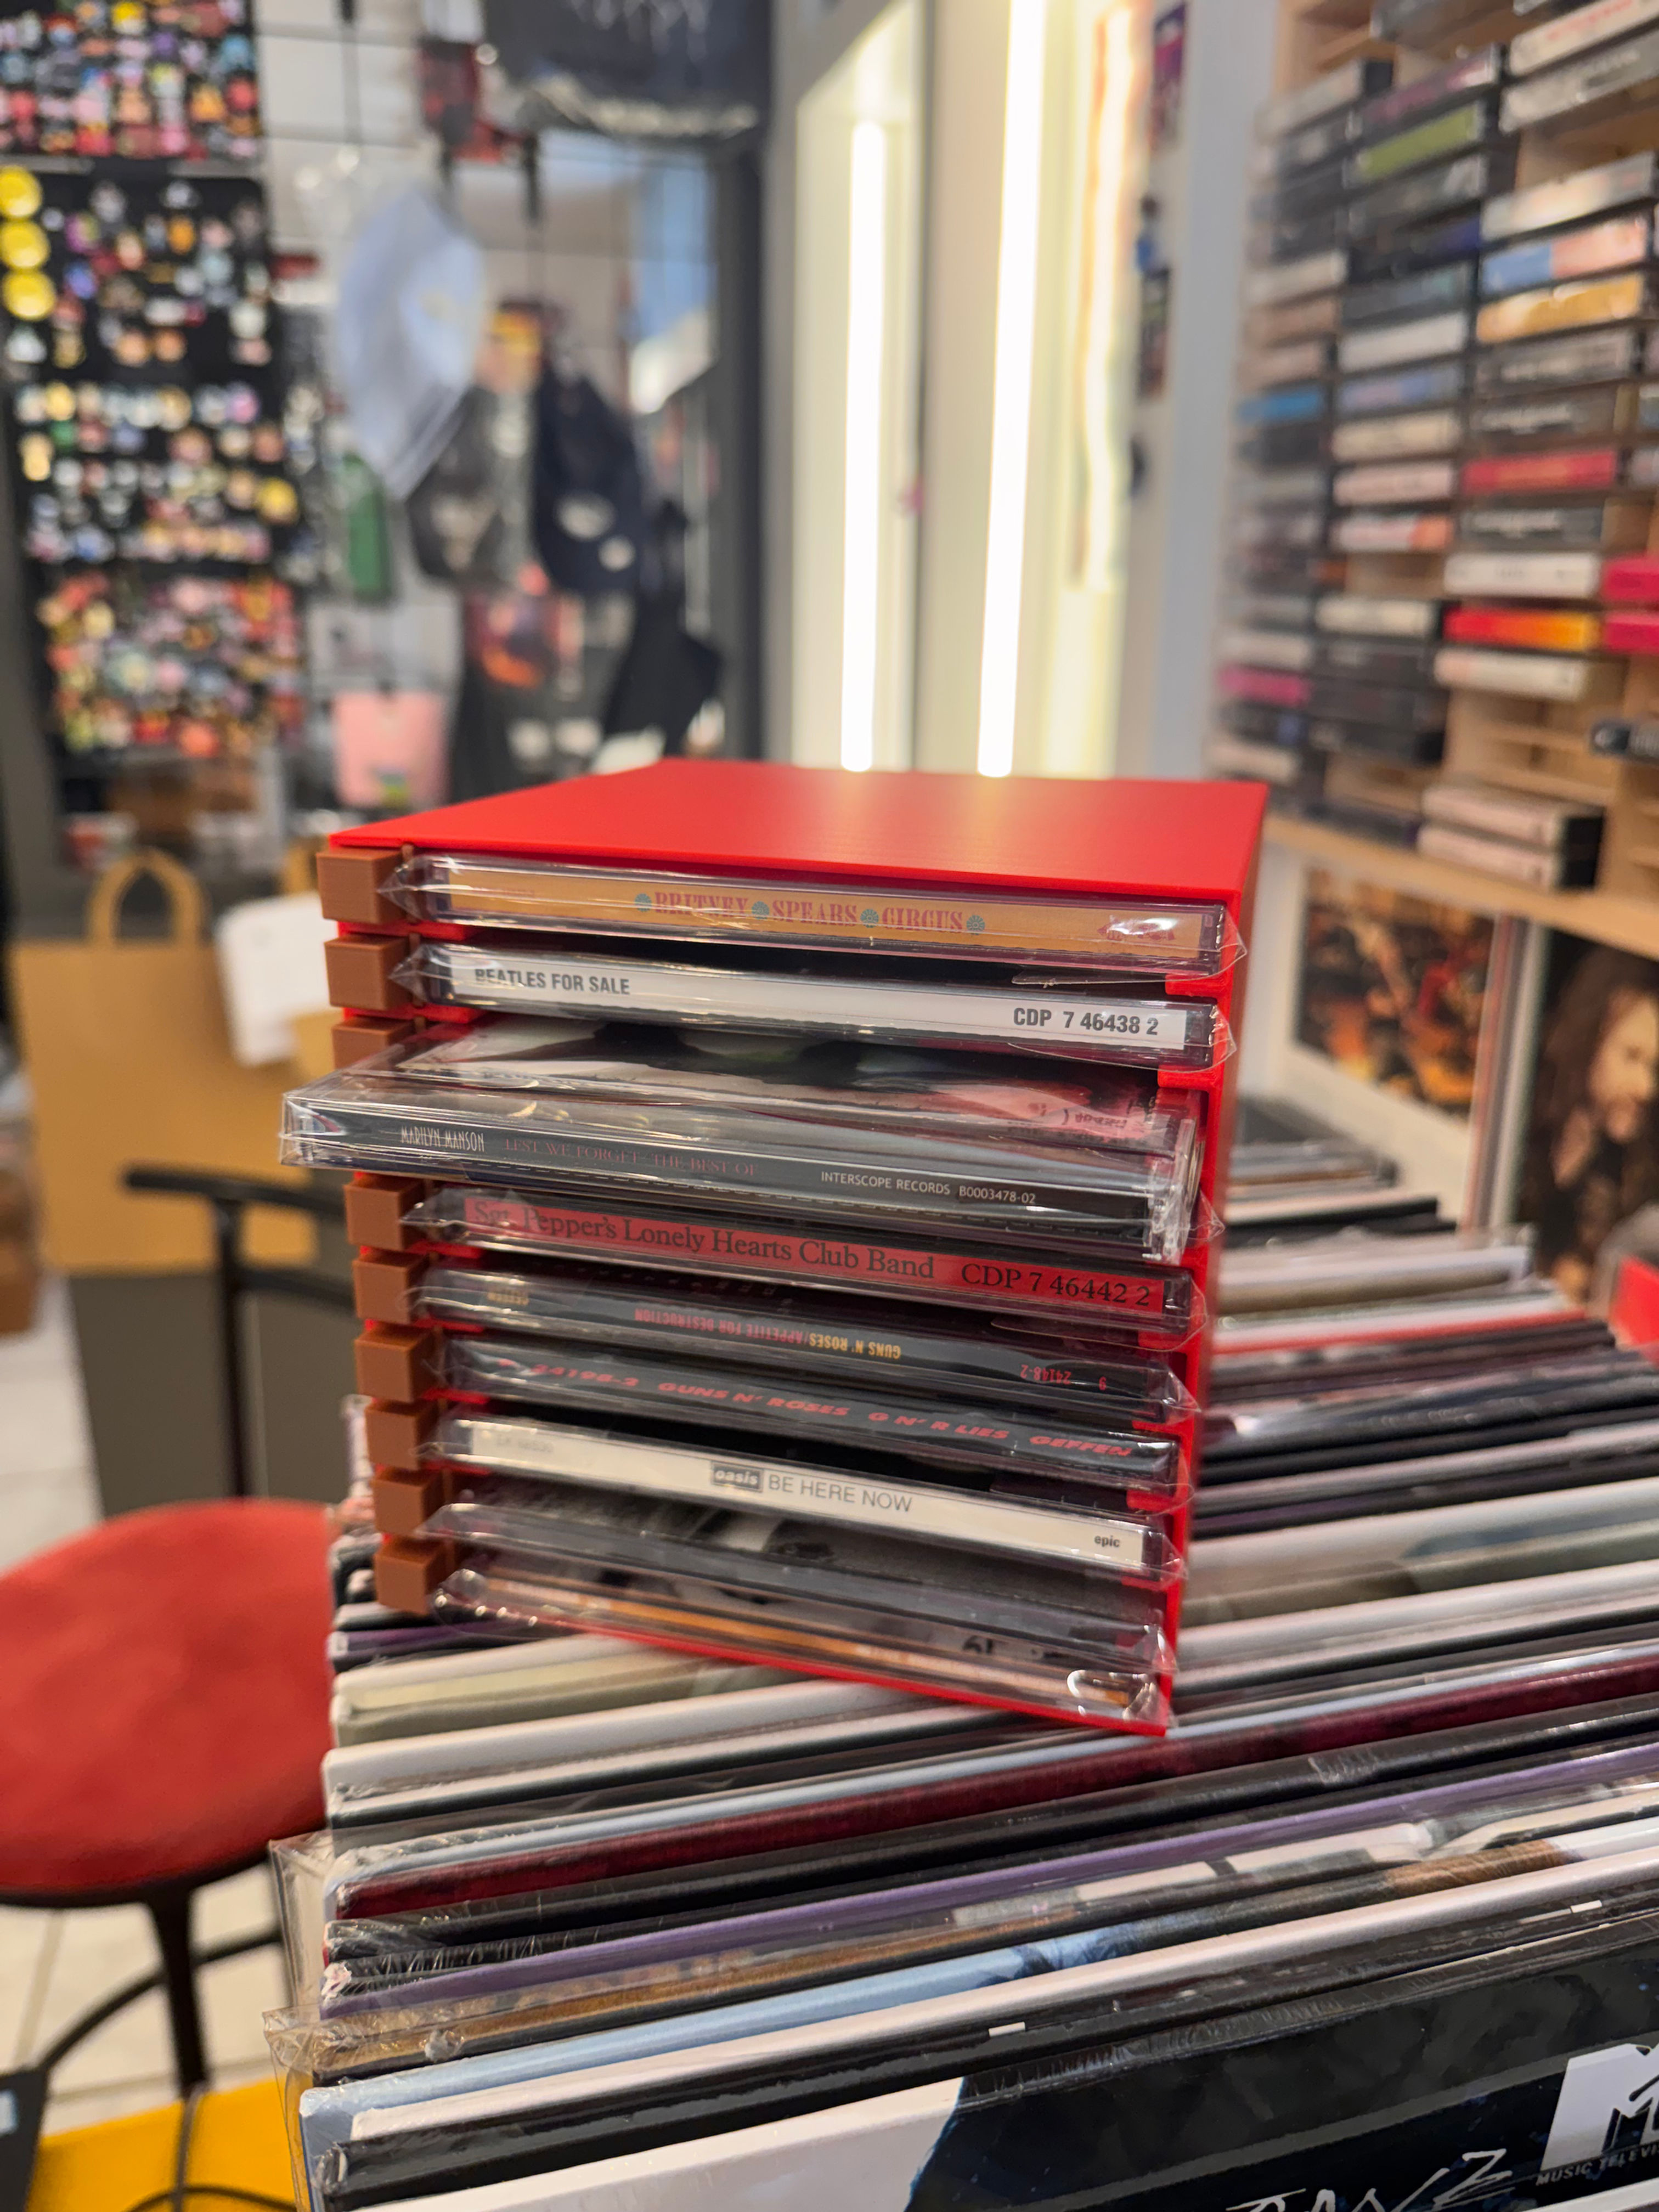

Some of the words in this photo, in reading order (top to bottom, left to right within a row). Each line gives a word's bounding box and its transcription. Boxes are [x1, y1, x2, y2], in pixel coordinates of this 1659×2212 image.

[654, 892, 748, 918] BRITNEY
[772, 900, 857, 927] SPEARS
[882, 907, 963, 933] CIRCUS
[475, 969, 546, 988] BEATLES
[551, 973, 584, 992] FOR
[589, 976, 630, 995] SALE
[1013, 1007, 1052, 1026] CDP
[1063, 1011, 1074, 1028] 7
[1080, 1012, 1141, 1034] 46438
[1146, 1017, 1159, 1035] 2
[400, 1126, 441, 1147] MARILYN
[444, 1130, 485, 1152] MANSON
[577, 1146, 639, 1164] FORGET
[821, 1171, 892, 1189] INTERSCOPE
[896, 1178, 950, 1195] RECORDS
[959, 1186, 1036, 1205] B0003478-02
[624, 1219, 706, 1254] Lonely
[712, 1229, 792, 1261] Hearts
[799, 1240, 859, 1268] Club
[866, 1248, 934, 1278] Band
[962, 1263, 1021, 1289] CDP
[1029, 1272, 1042, 1291] 7
[1049, 1276, 1128, 1304] 46442
[1135, 1286, 1150, 1306] 2
[634, 1308, 714, 1332] DESTRUCTION
[718, 1320, 741, 1335] FOR
[868, 1341, 901, 1359] GUNS
[1020, 1364, 1071, 1385] 24148-2
[658, 1383, 729, 1398] GUNS
[766, 1397, 850, 1416] ROSES
[930, 1420, 950, 1431] R
[954, 1424, 1010, 1440] LIES
[1029, 1435, 1133, 1457] GEFFEN
[714, 1468, 759, 1486] oasis
[769, 1474, 793, 1493] BE
[800, 1480, 855, 1503] HERE
[862, 1489, 913, 1512] NOW
[1094, 1534, 1121, 1548] epic
[1536, 2161, 1593, 2186] MUSIC
[1598, 2141, 1659, 2171] TELEVI
